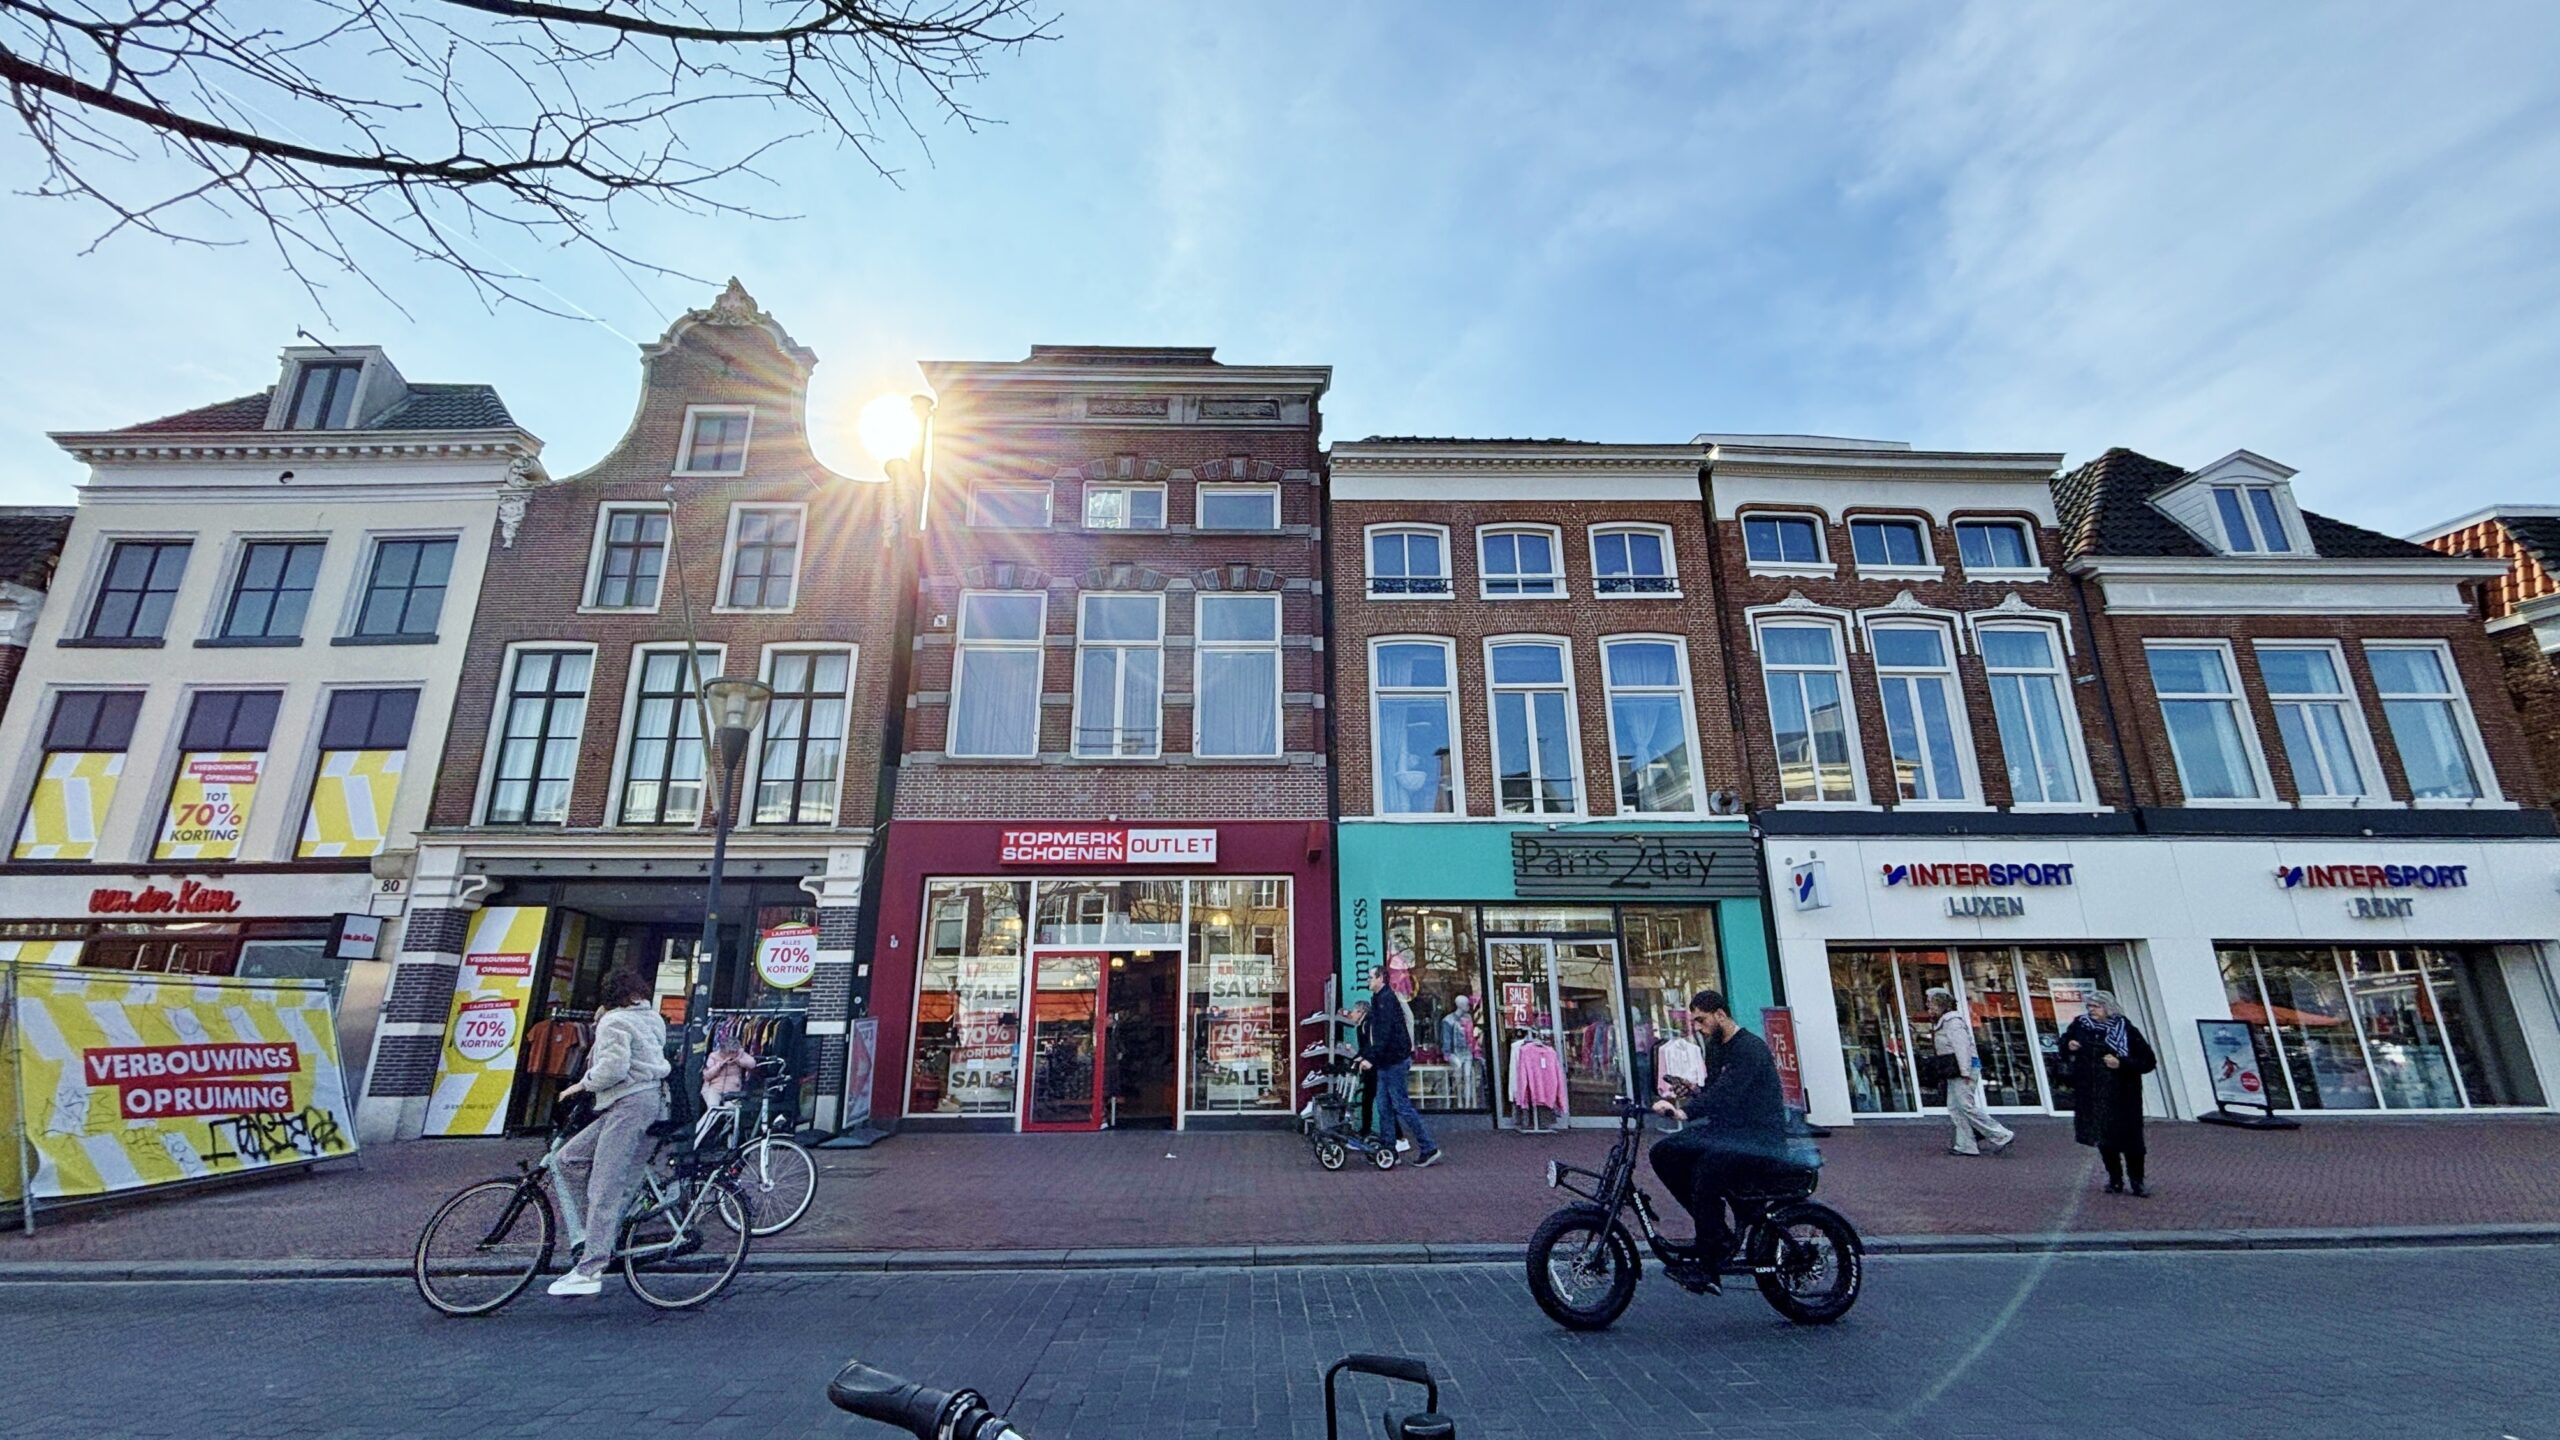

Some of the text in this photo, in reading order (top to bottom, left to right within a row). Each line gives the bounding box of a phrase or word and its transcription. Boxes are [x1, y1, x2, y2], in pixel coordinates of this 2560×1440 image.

[206, 793, 228, 801] TOT
[176, 803, 242, 826] 70%
[169, 829, 239, 842] KORTING
[1004, 832, 1122, 845] TOPMERK
[1002, 847, 1122, 861] SCHOENEN
[1131, 838, 1213, 853] OUTLET
[1908, 863, 2074, 887] INTERSPORT
[2305, 865, 2467, 888] INTERSPORT
[381, 879, 400, 892] 80
[1946, 896, 2025, 917] LUXEN
[2349, 898, 2414, 918] RENT
[1350, 898, 1376, 991] impress
[770, 947, 810, 963] 70%
[766, 965, 809, 974] KORTING
[1509, 987, 1529, 1001] SALE
[1511, 1003, 1527, 1022] 75
[466, 1021, 506, 1038] 70%
[460, 1040, 504, 1048] KORTING
[1773, 1033, 1787, 1052] 75
[89, 1047, 293, 1080] VERBOUWINGS
[1774, 1053, 1797, 1071] ALE
[126, 1086, 289, 1114] OPRUIMING
